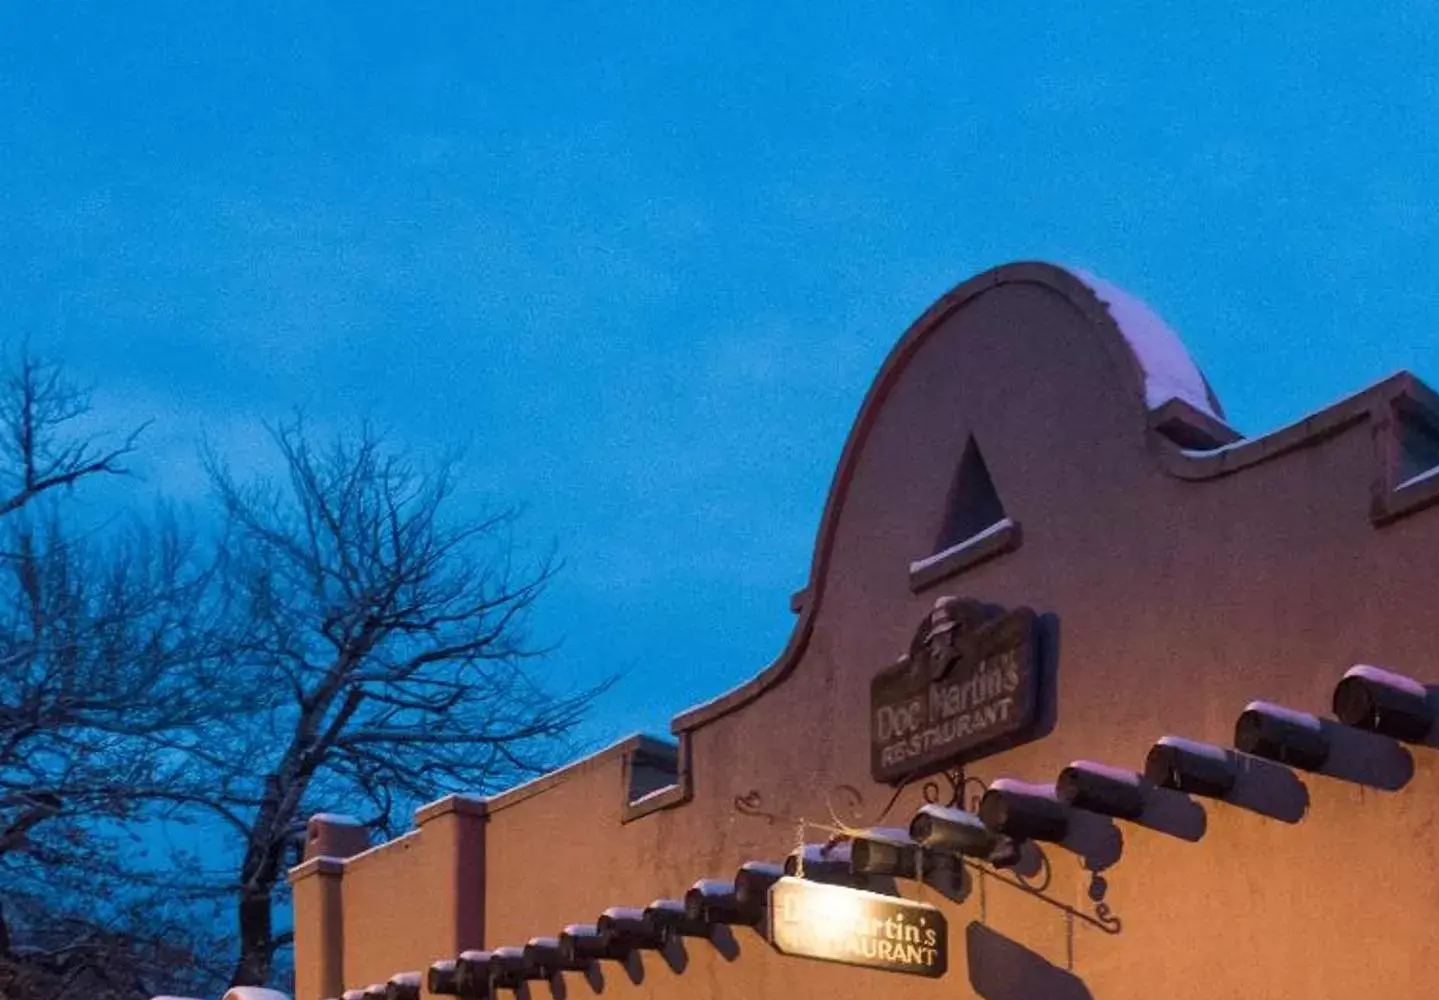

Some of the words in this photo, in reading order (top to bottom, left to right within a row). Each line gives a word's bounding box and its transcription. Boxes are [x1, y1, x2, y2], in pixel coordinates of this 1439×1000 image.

[877, 701, 921, 743] Doc
[929, 654, 1020, 722] Martin's
[881, 698, 1013, 768] RESTAURANT
